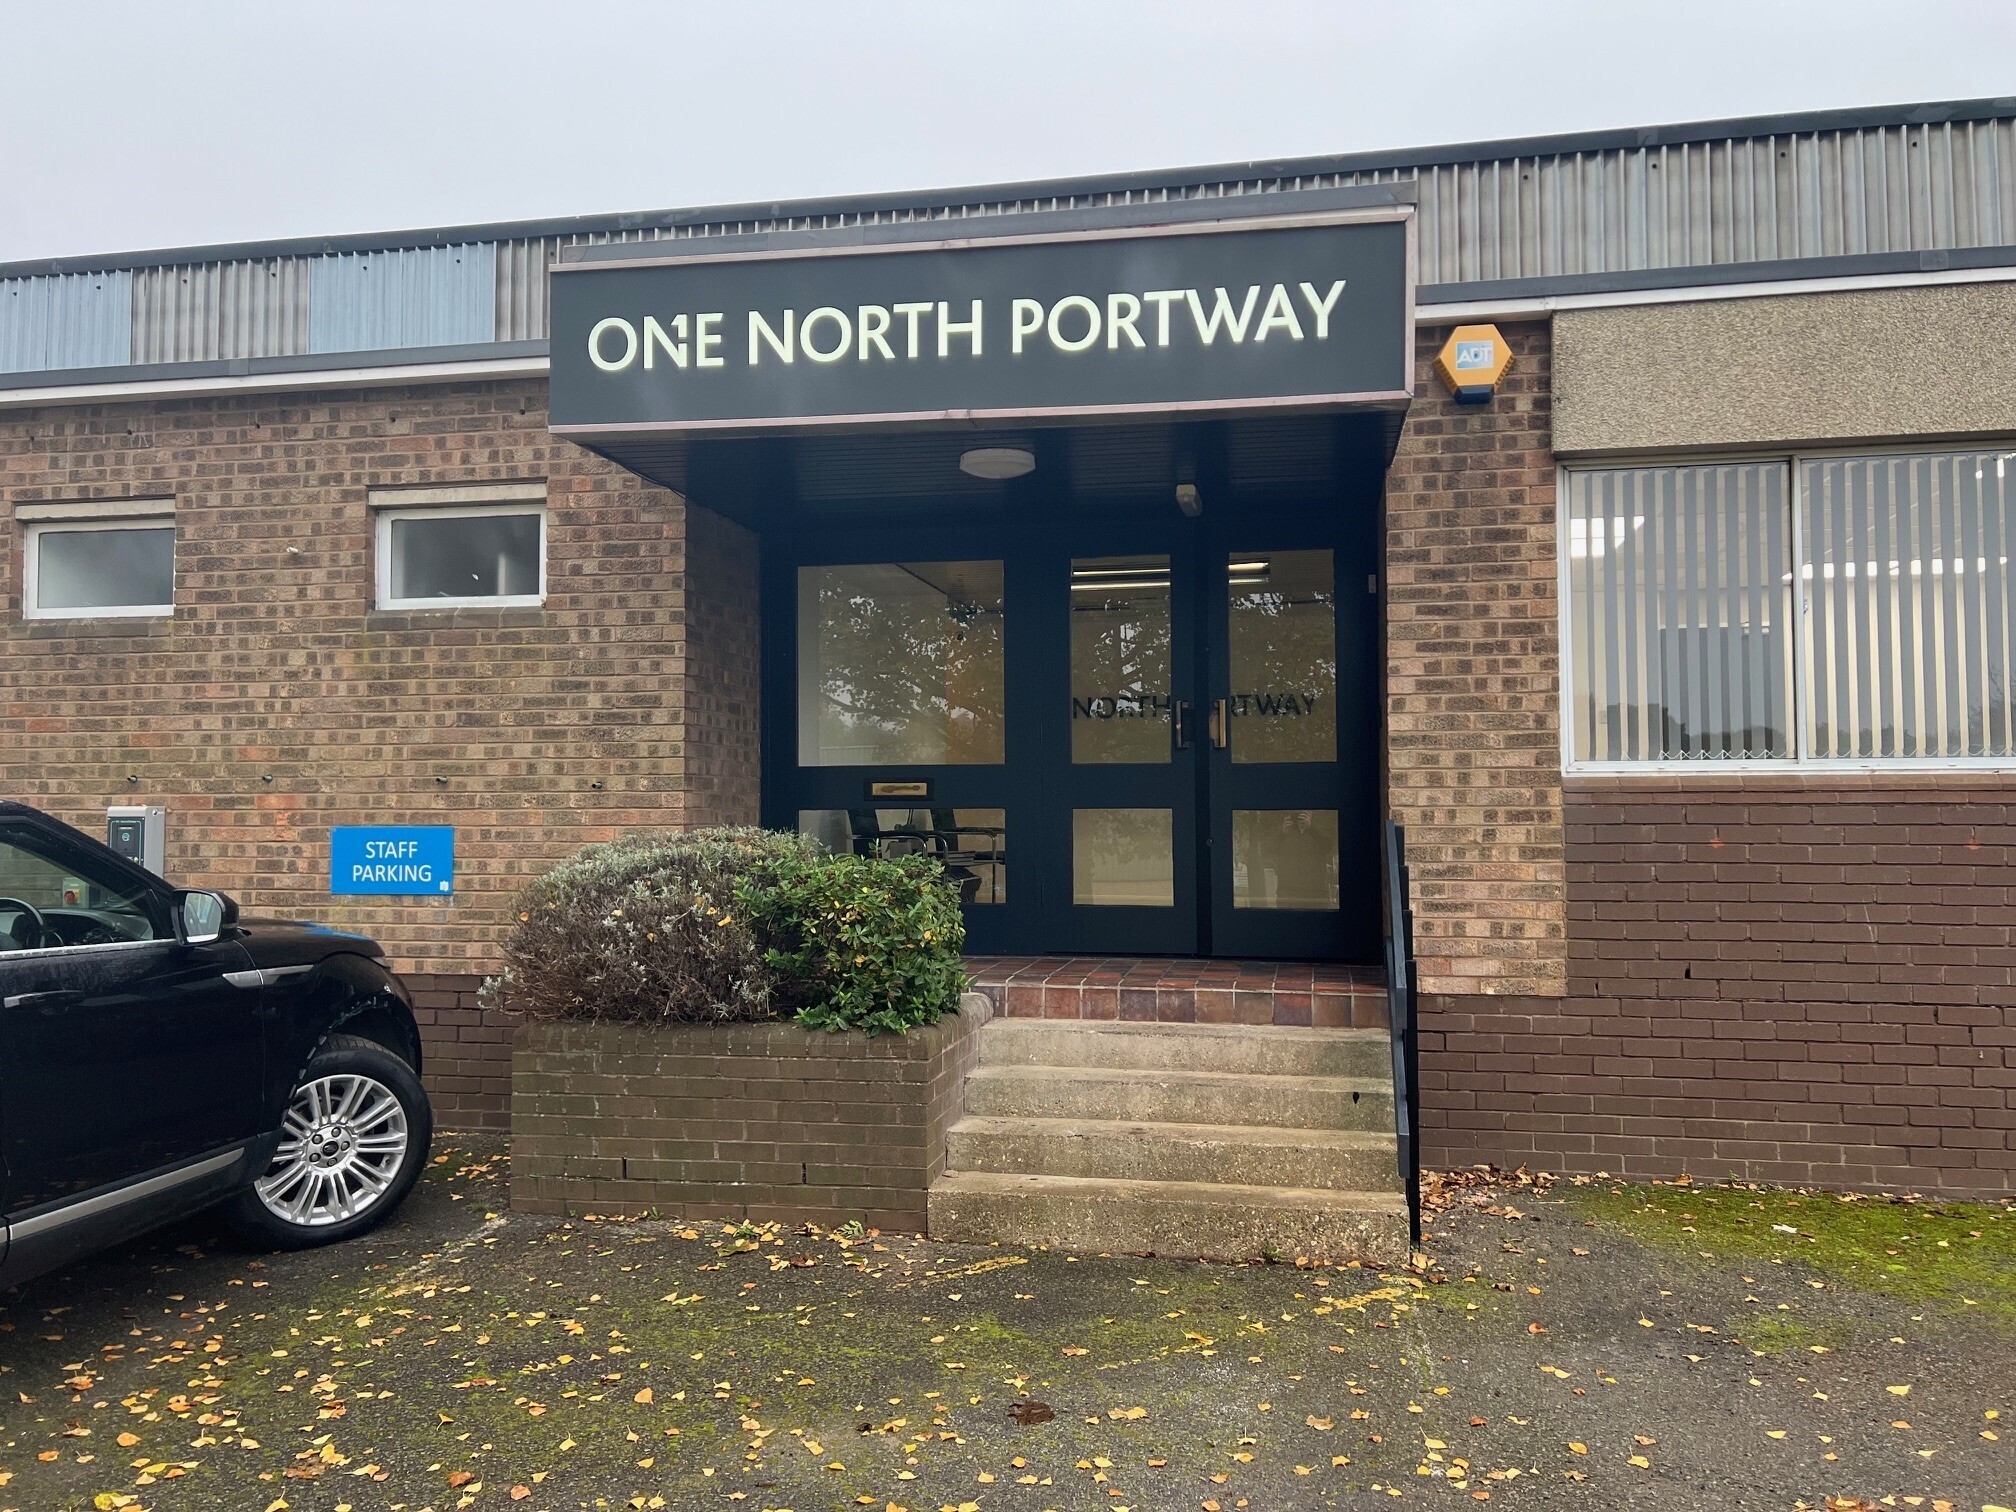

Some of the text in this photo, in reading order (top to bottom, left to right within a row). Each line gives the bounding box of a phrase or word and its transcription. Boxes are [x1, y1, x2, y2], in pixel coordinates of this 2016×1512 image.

[588, 280, 1347, 371] ONE NORTH PORTWAY
[1456, 345, 1494, 364] ADT
[365, 841, 418, 859] STAFF
[352, 864, 432, 882] PARKING
